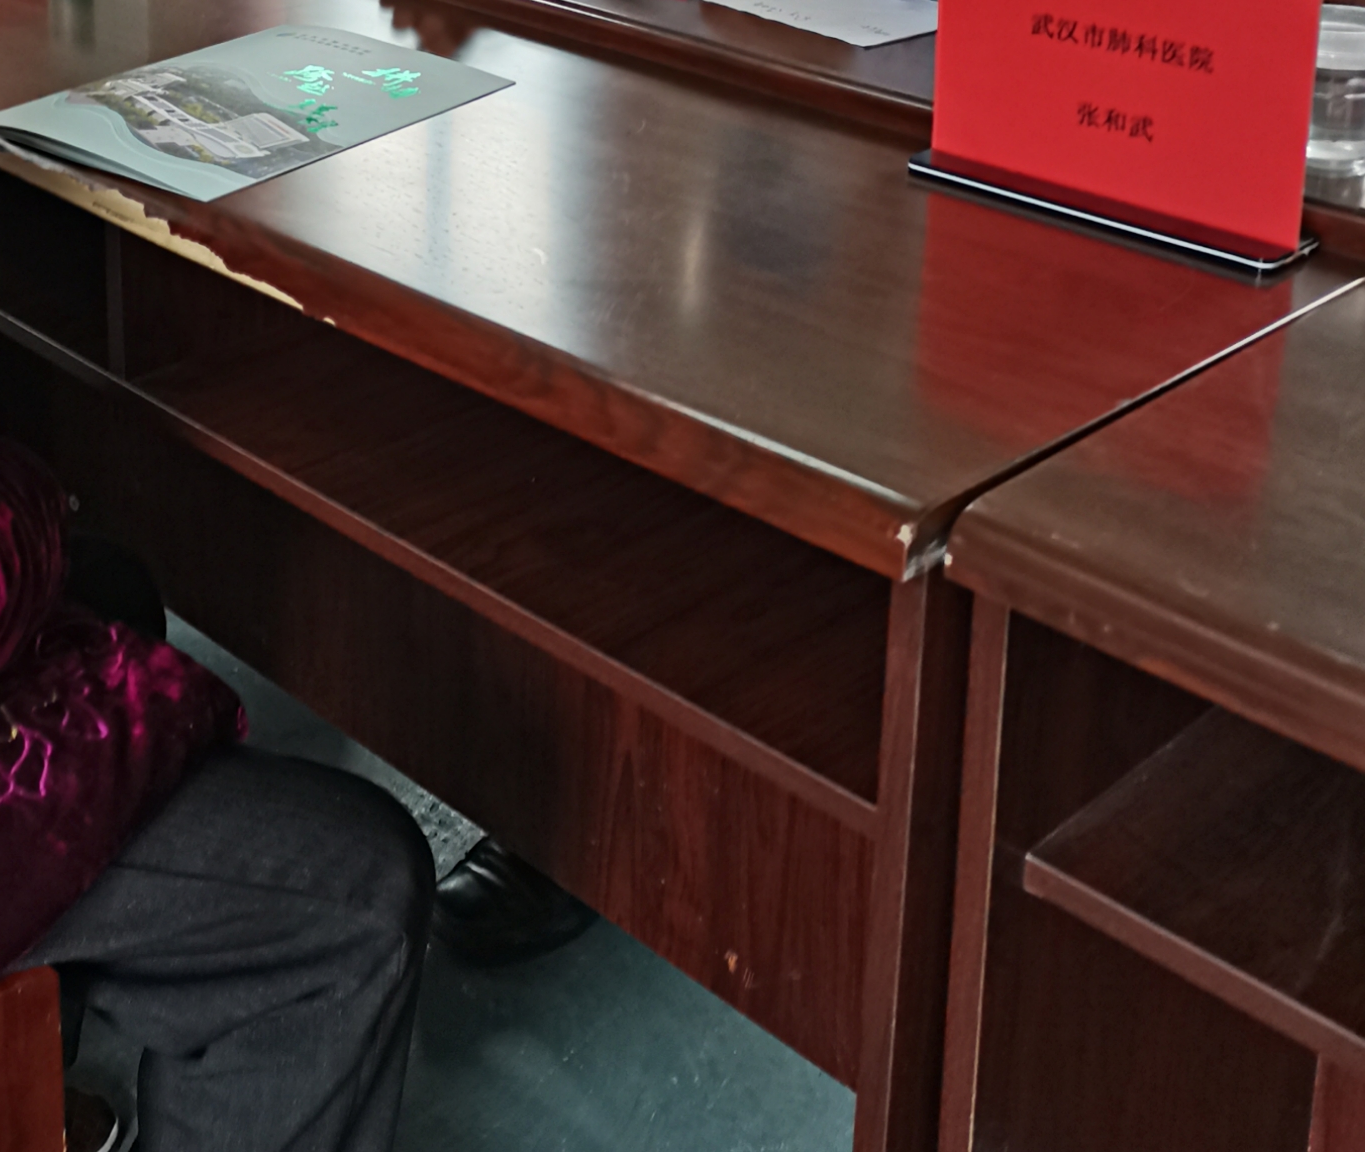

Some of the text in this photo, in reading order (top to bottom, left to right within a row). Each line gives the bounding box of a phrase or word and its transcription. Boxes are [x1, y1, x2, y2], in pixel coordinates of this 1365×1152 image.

[1031, 12, 1215, 74] 武汉市肺科医院
[1077, 101, 1155, 143] 张和武
